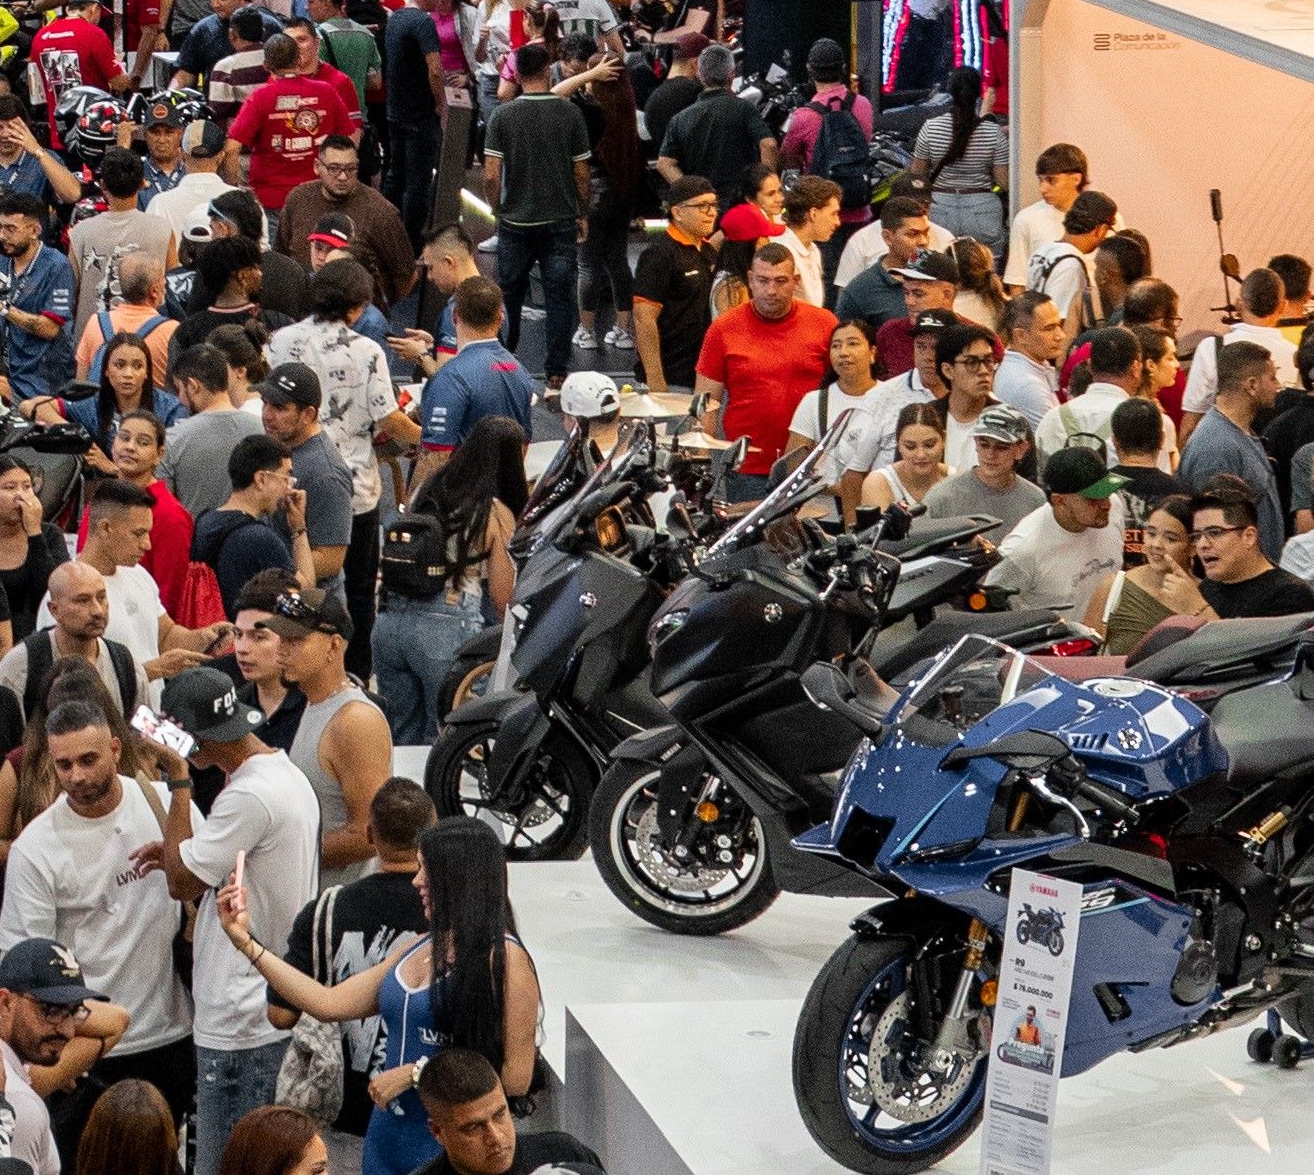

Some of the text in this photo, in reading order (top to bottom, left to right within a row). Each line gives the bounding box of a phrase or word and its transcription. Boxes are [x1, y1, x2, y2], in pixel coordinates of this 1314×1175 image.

[1113, 32, 1166, 43] Plaza de la
[1035, 885, 1060, 898] YAMAHA
